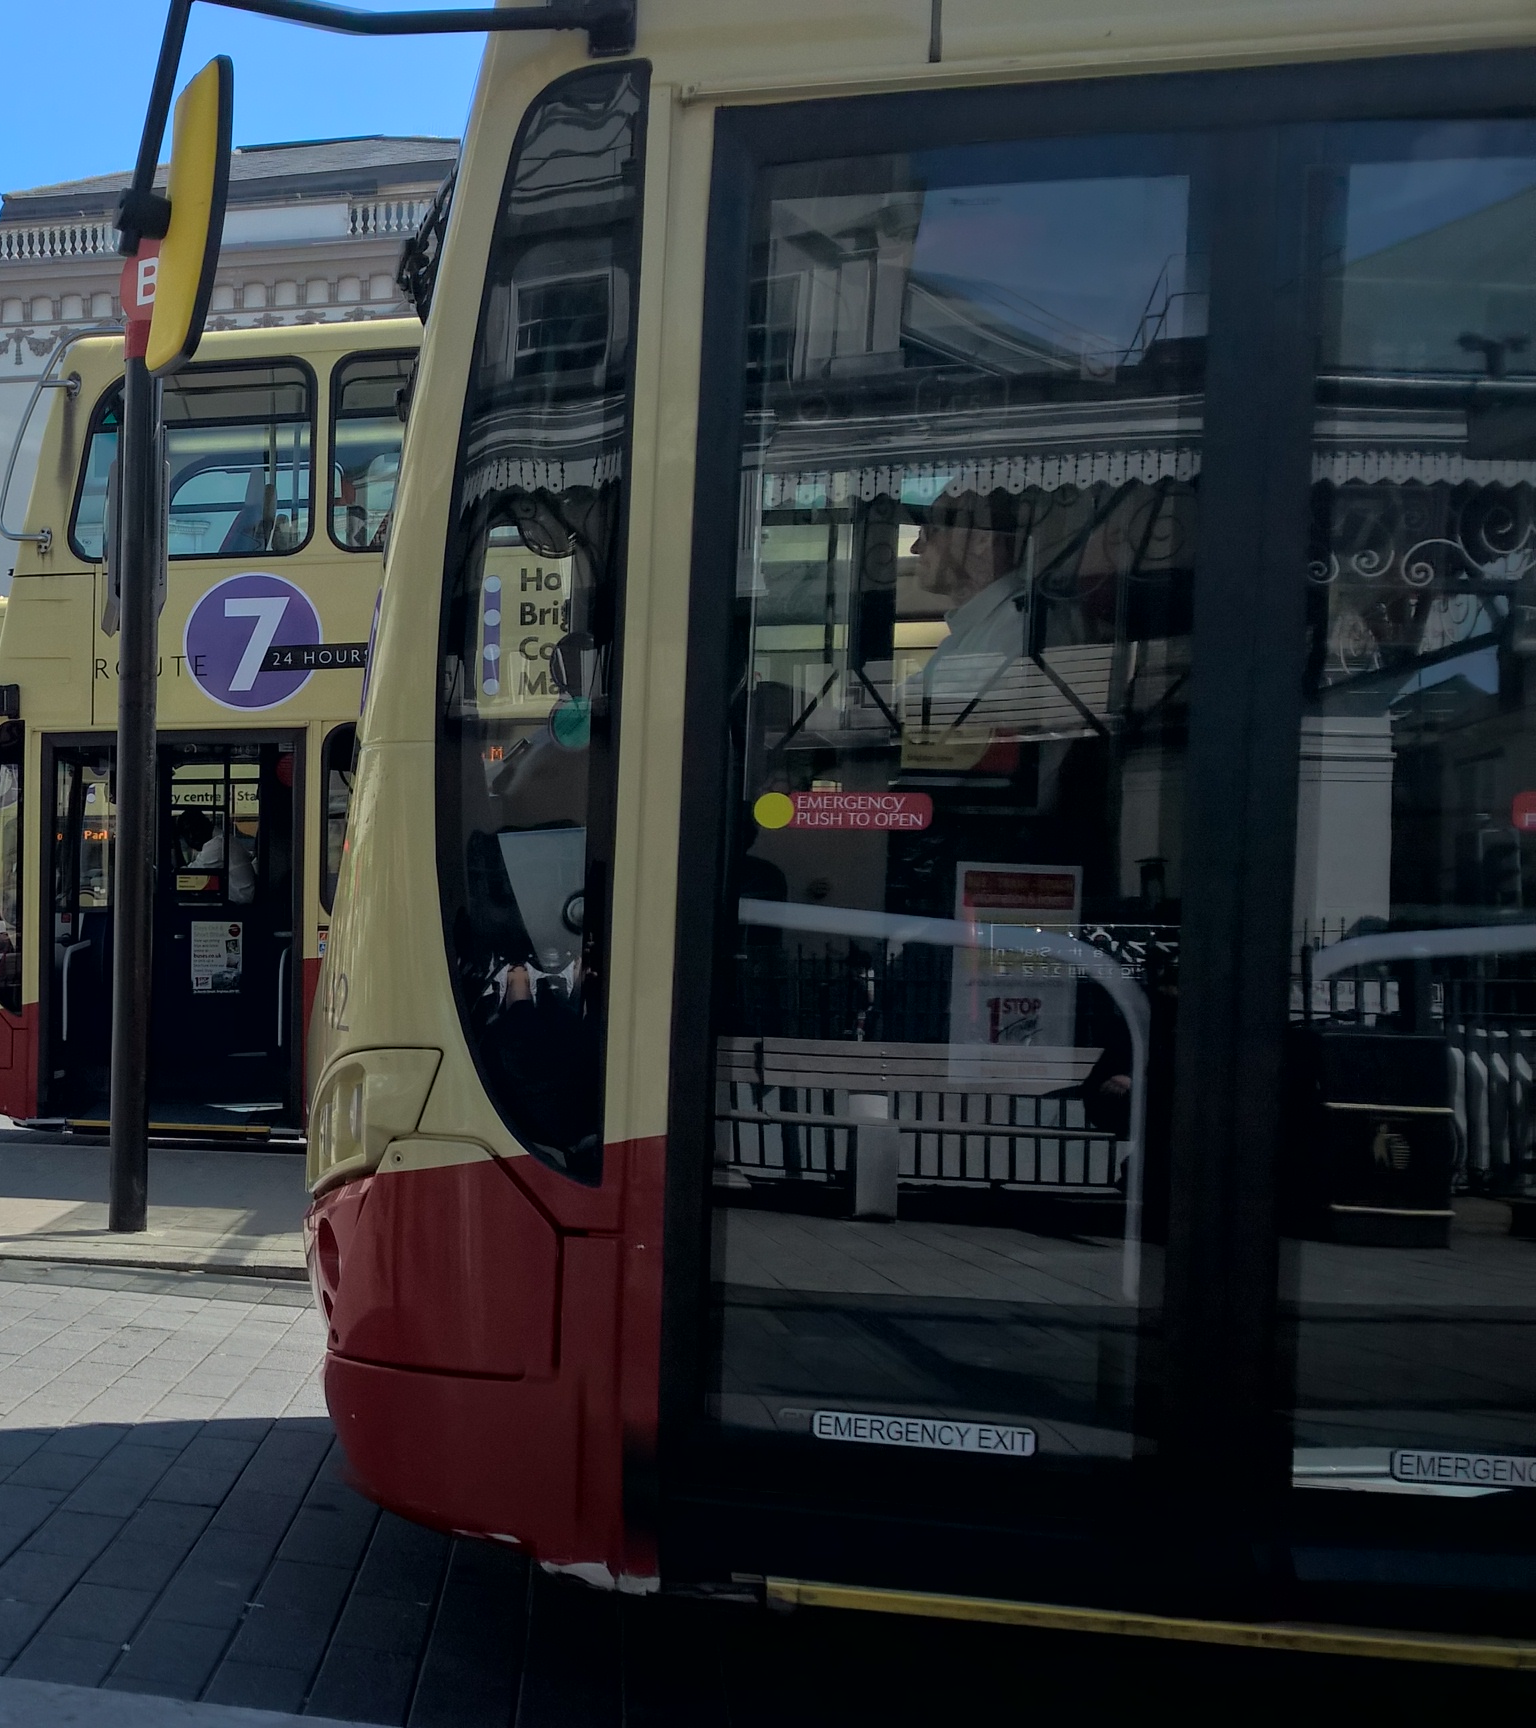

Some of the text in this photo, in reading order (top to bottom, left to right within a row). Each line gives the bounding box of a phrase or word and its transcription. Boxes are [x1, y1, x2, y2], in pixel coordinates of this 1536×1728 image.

[137, 257, 158, 306] B
[520, 568, 562, 591] Ho
[224, 597, 290, 691] 7
[519, 636, 556, 660] Co
[95, 655, 207, 679] RTE
[272, 652, 292, 666] 24
[518, 671, 560, 696] Ma
[184, 792, 221, 802] centre
[797, 795, 906, 812] EMERGENCY
[797, 812, 923, 826] PUSH TO OPEN
[1002, 997, 1041, 1014] STOP
[818, 1414, 1032, 1452] EMERGENCY EXIT
[1400, 1454, 1536, 1483] EMERGEN
